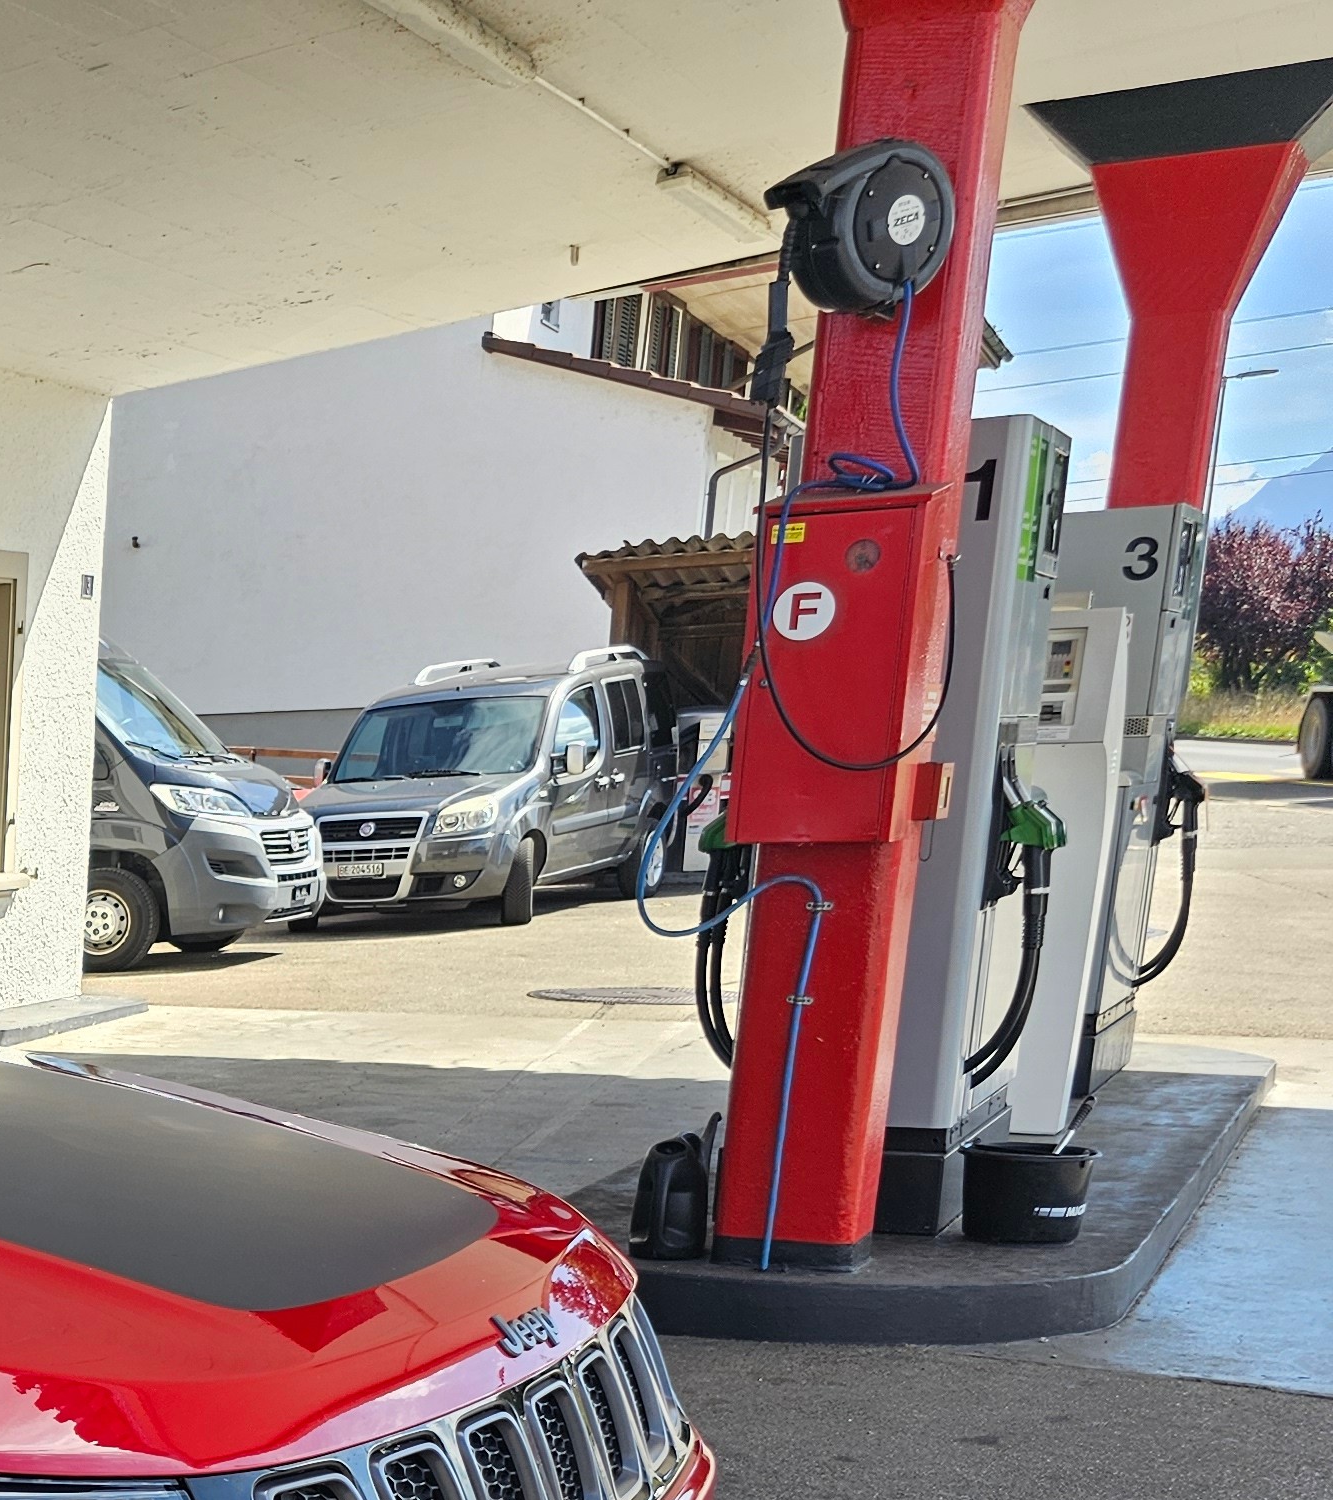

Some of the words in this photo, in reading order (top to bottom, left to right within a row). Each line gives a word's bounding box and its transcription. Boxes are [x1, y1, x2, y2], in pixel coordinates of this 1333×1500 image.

[893, 212, 919, 227] ZECA
[964, 458, 997, 521] 1
[1122, 536, 1159, 581] 3
[788, 592, 822, 631] F
[339, 865, 349, 875] BE
[489, 1306, 560, 1358] Jeep
